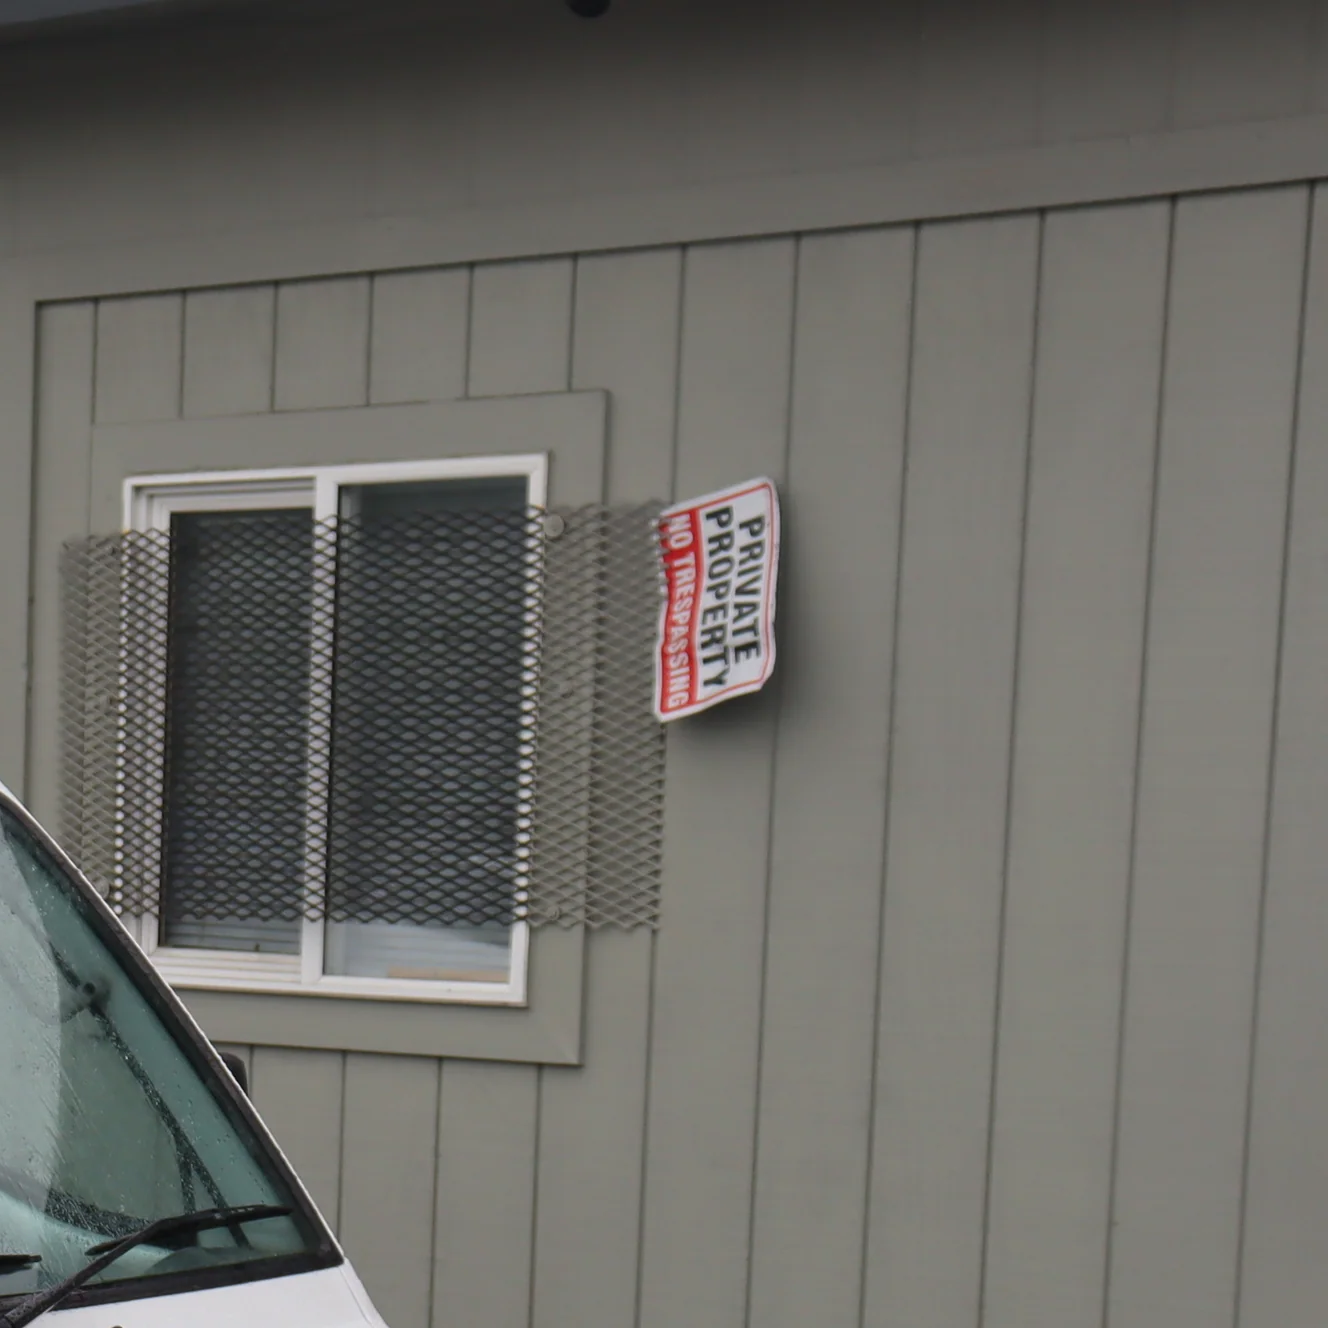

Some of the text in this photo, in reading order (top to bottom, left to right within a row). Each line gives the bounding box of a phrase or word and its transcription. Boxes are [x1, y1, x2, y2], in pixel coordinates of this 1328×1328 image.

[668, 513, 696, 709] NO TRESPASSING
[700, 506, 733, 688] PROPERTY
[732, 516, 765, 664] PRIVATE
